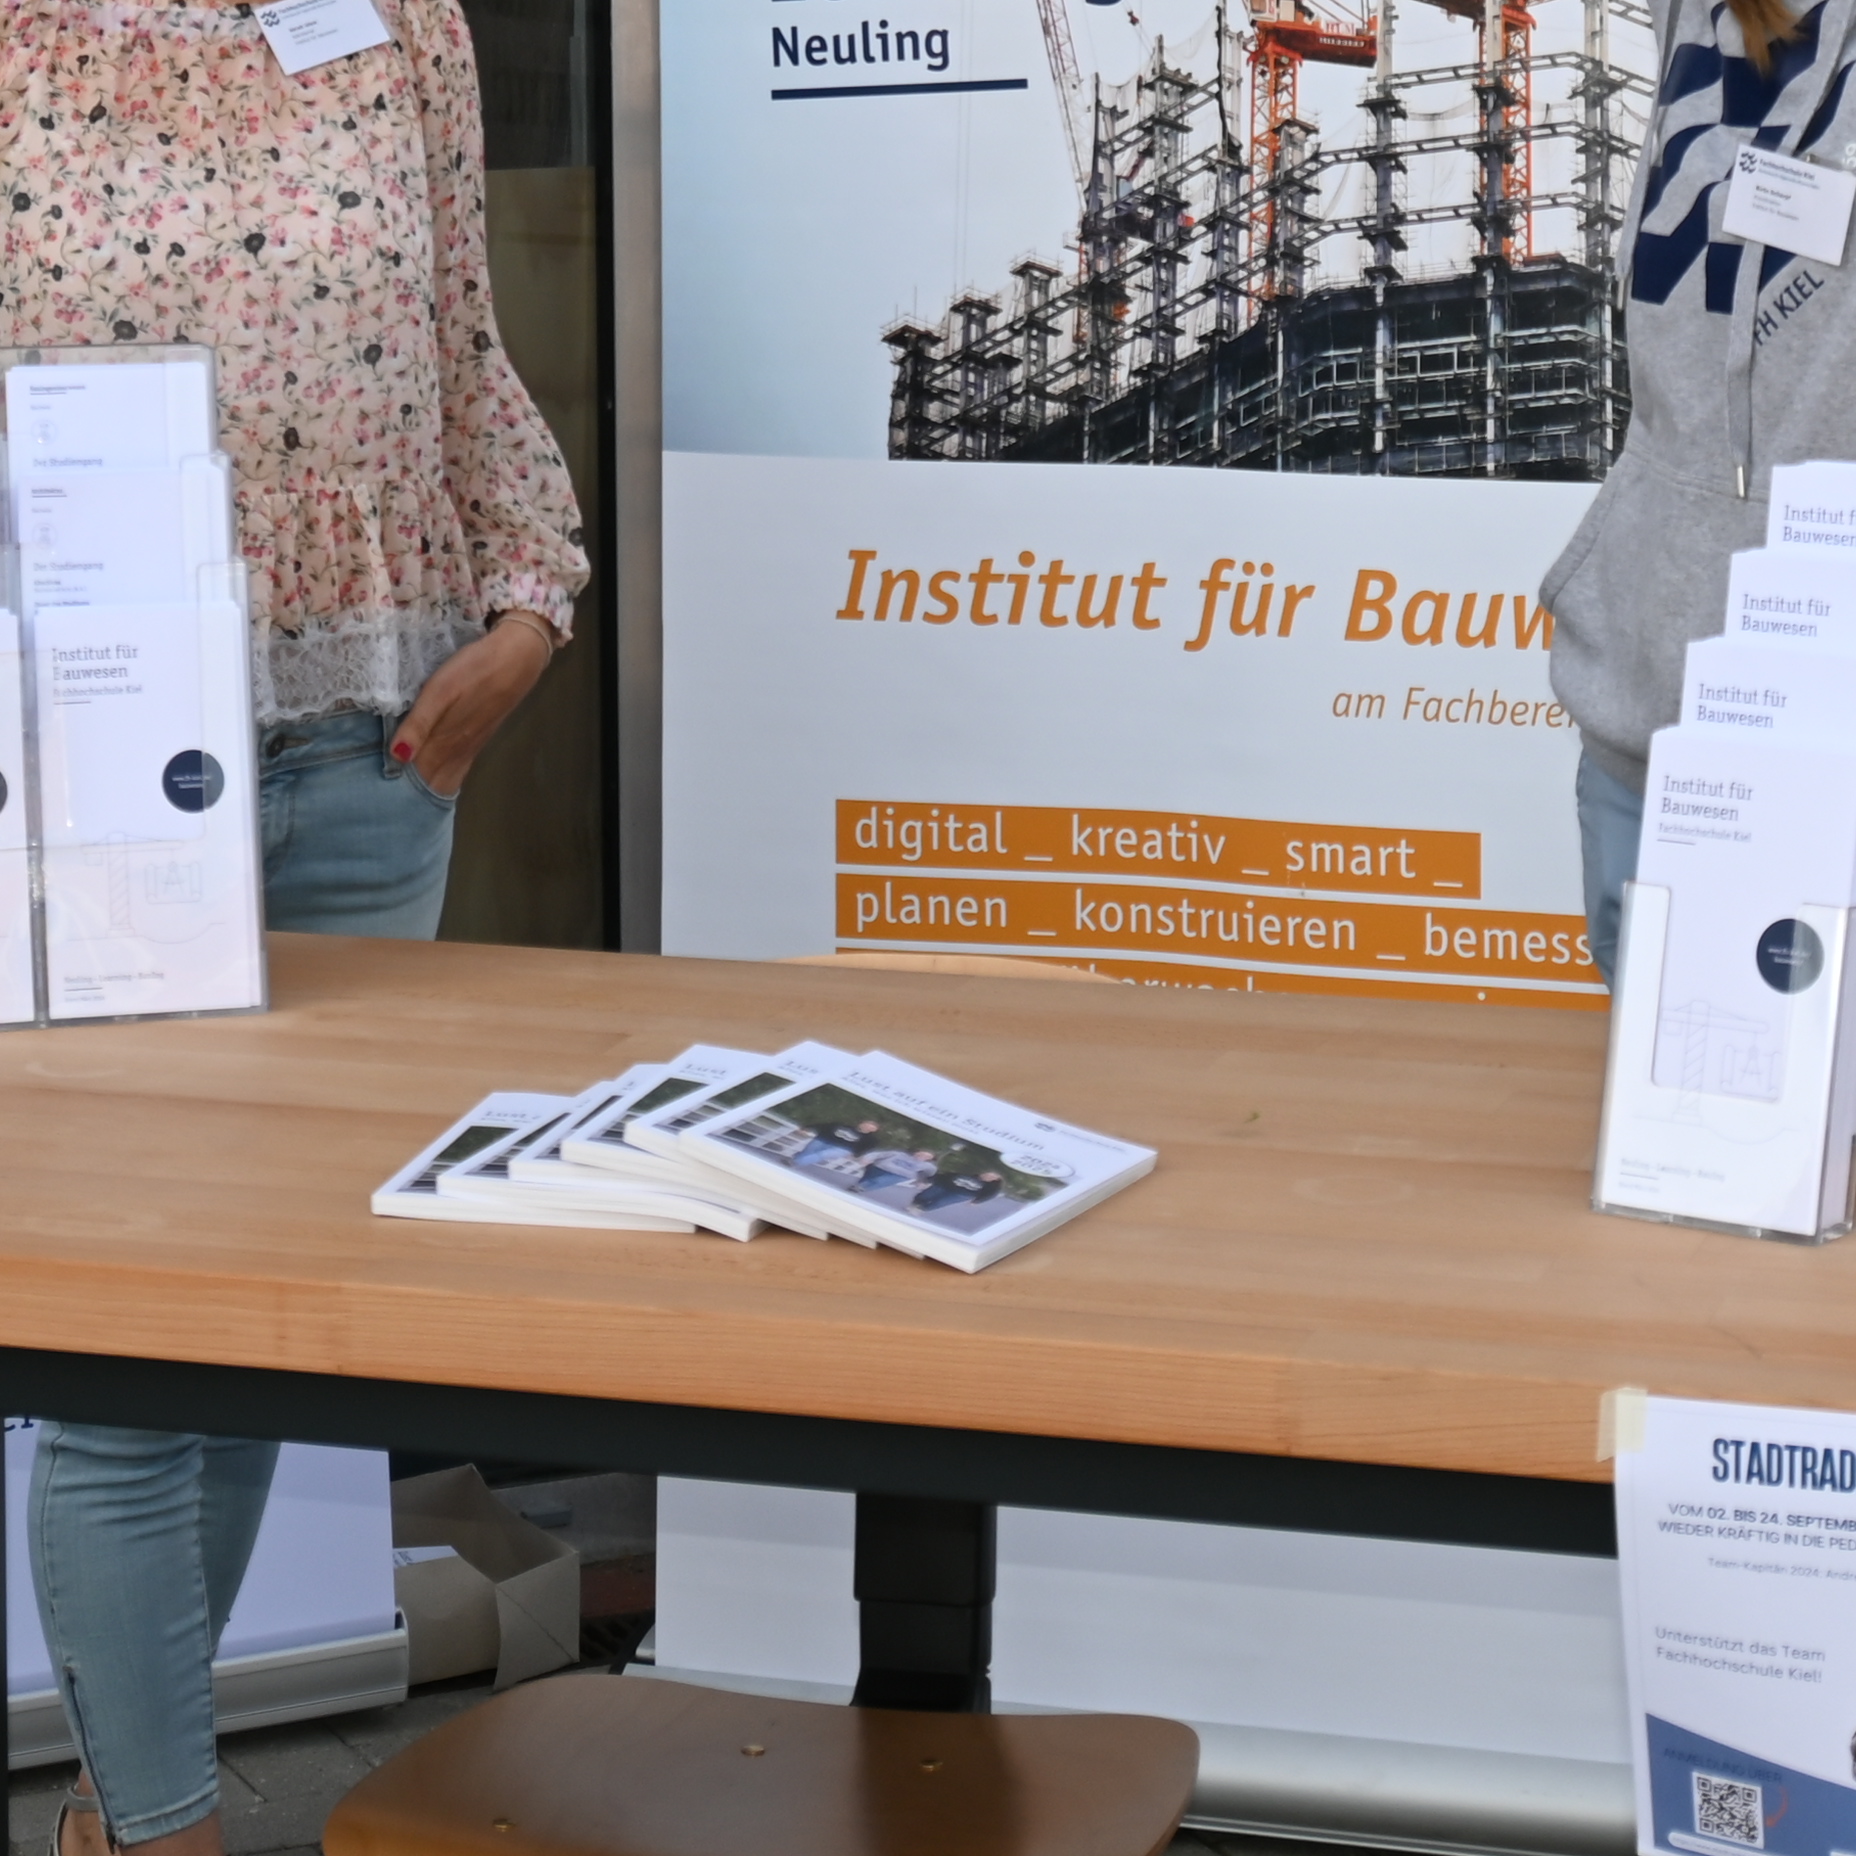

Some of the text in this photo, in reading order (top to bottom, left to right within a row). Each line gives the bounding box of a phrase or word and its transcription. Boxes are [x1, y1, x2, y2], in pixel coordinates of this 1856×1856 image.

[772, 19, 949, 71] Neuling
[1772, 269, 1825, 322] KIEL
[836, 549, 1316, 649] Institut für
[1332, 692, 1386, 719] am
[1661, 797, 1738, 821] Bauwesen
[1663, 775, 1753, 801] Institut für
[855, 806, 1008, 861] digital
[1072, 813, 1226, 864] kreativ
[1286, 839, 1416, 878] smart
[856, 882, 1007, 933] planen
[1075, 888, 1360, 950] konstruieren
